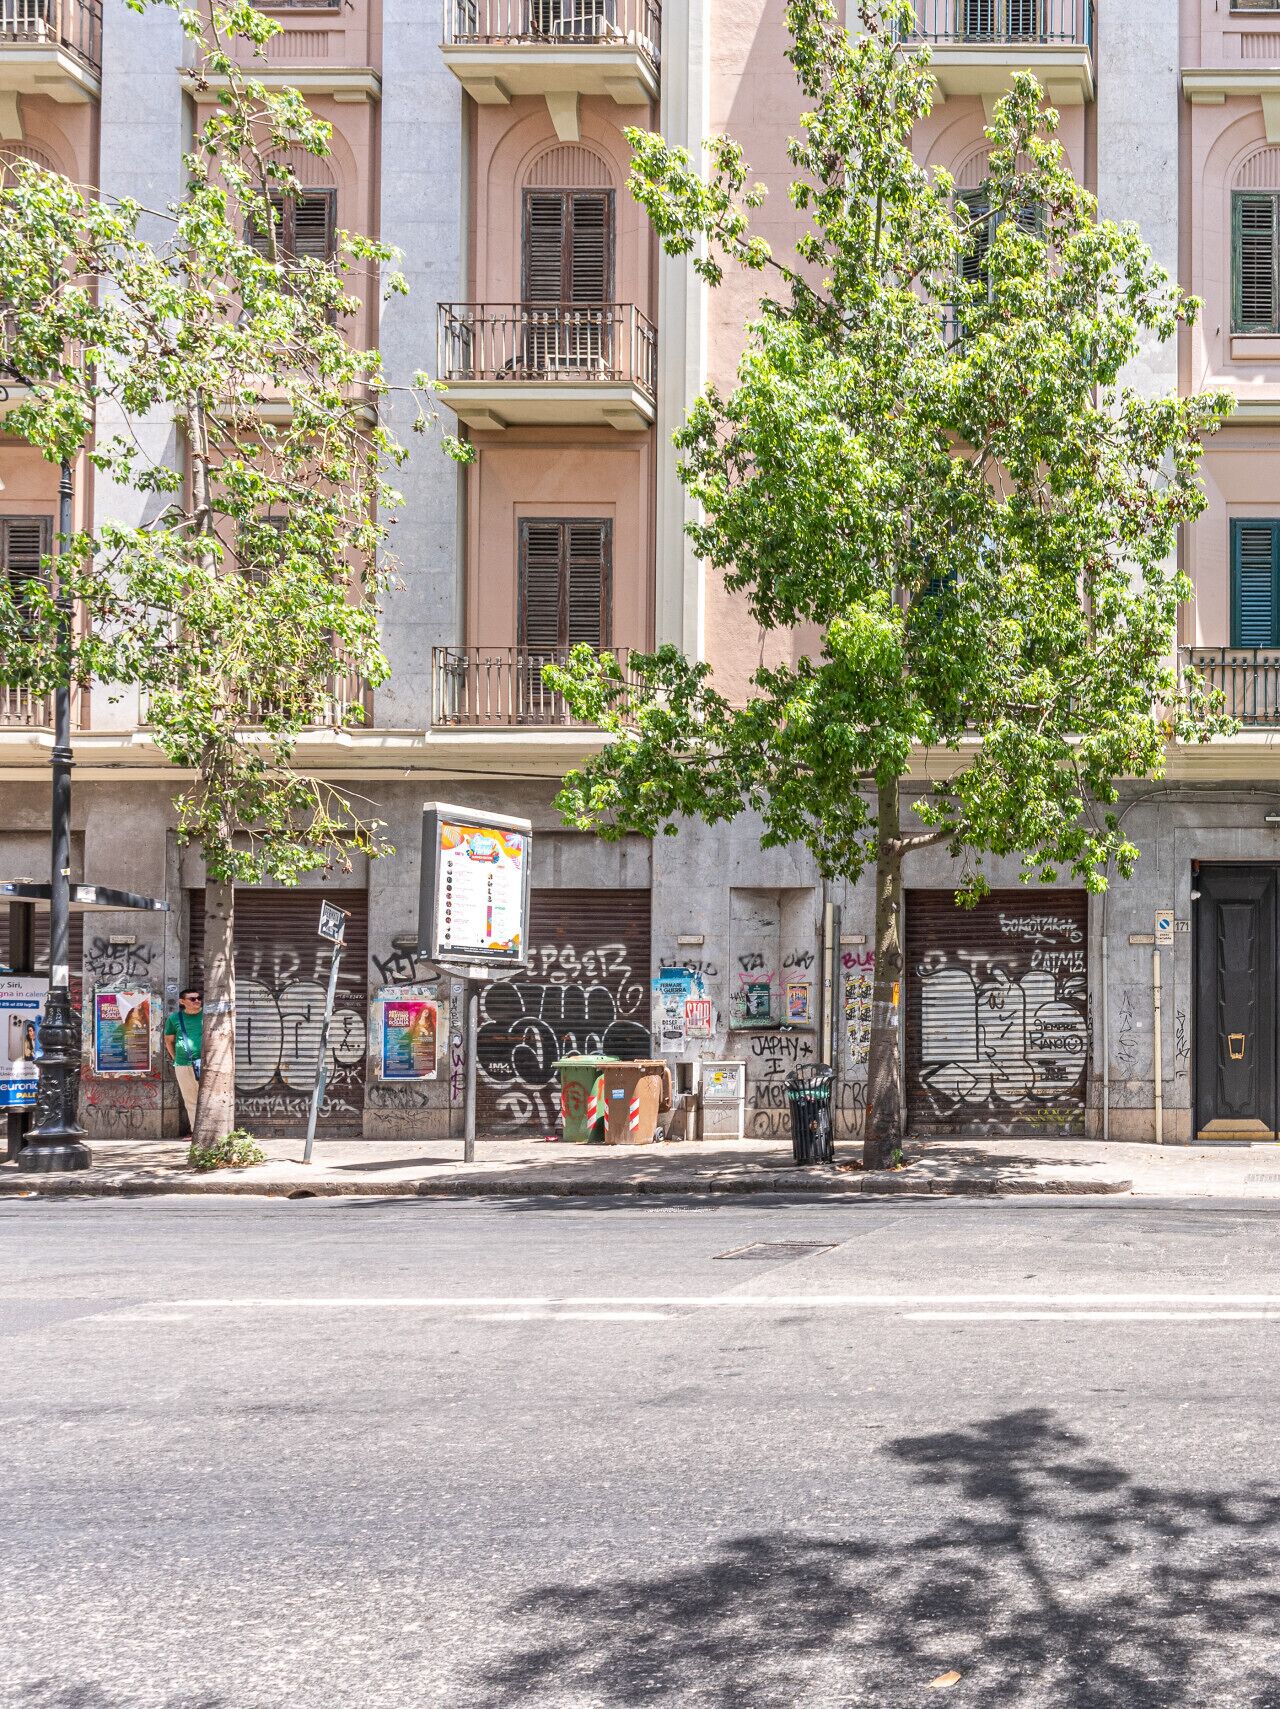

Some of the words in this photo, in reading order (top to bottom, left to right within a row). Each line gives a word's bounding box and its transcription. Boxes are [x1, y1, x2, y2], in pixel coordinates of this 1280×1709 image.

[1175, 921, 1190, 932] 171
[7, 981, 23, 989] Siri,
[686, 1002, 710, 1027] STOP
